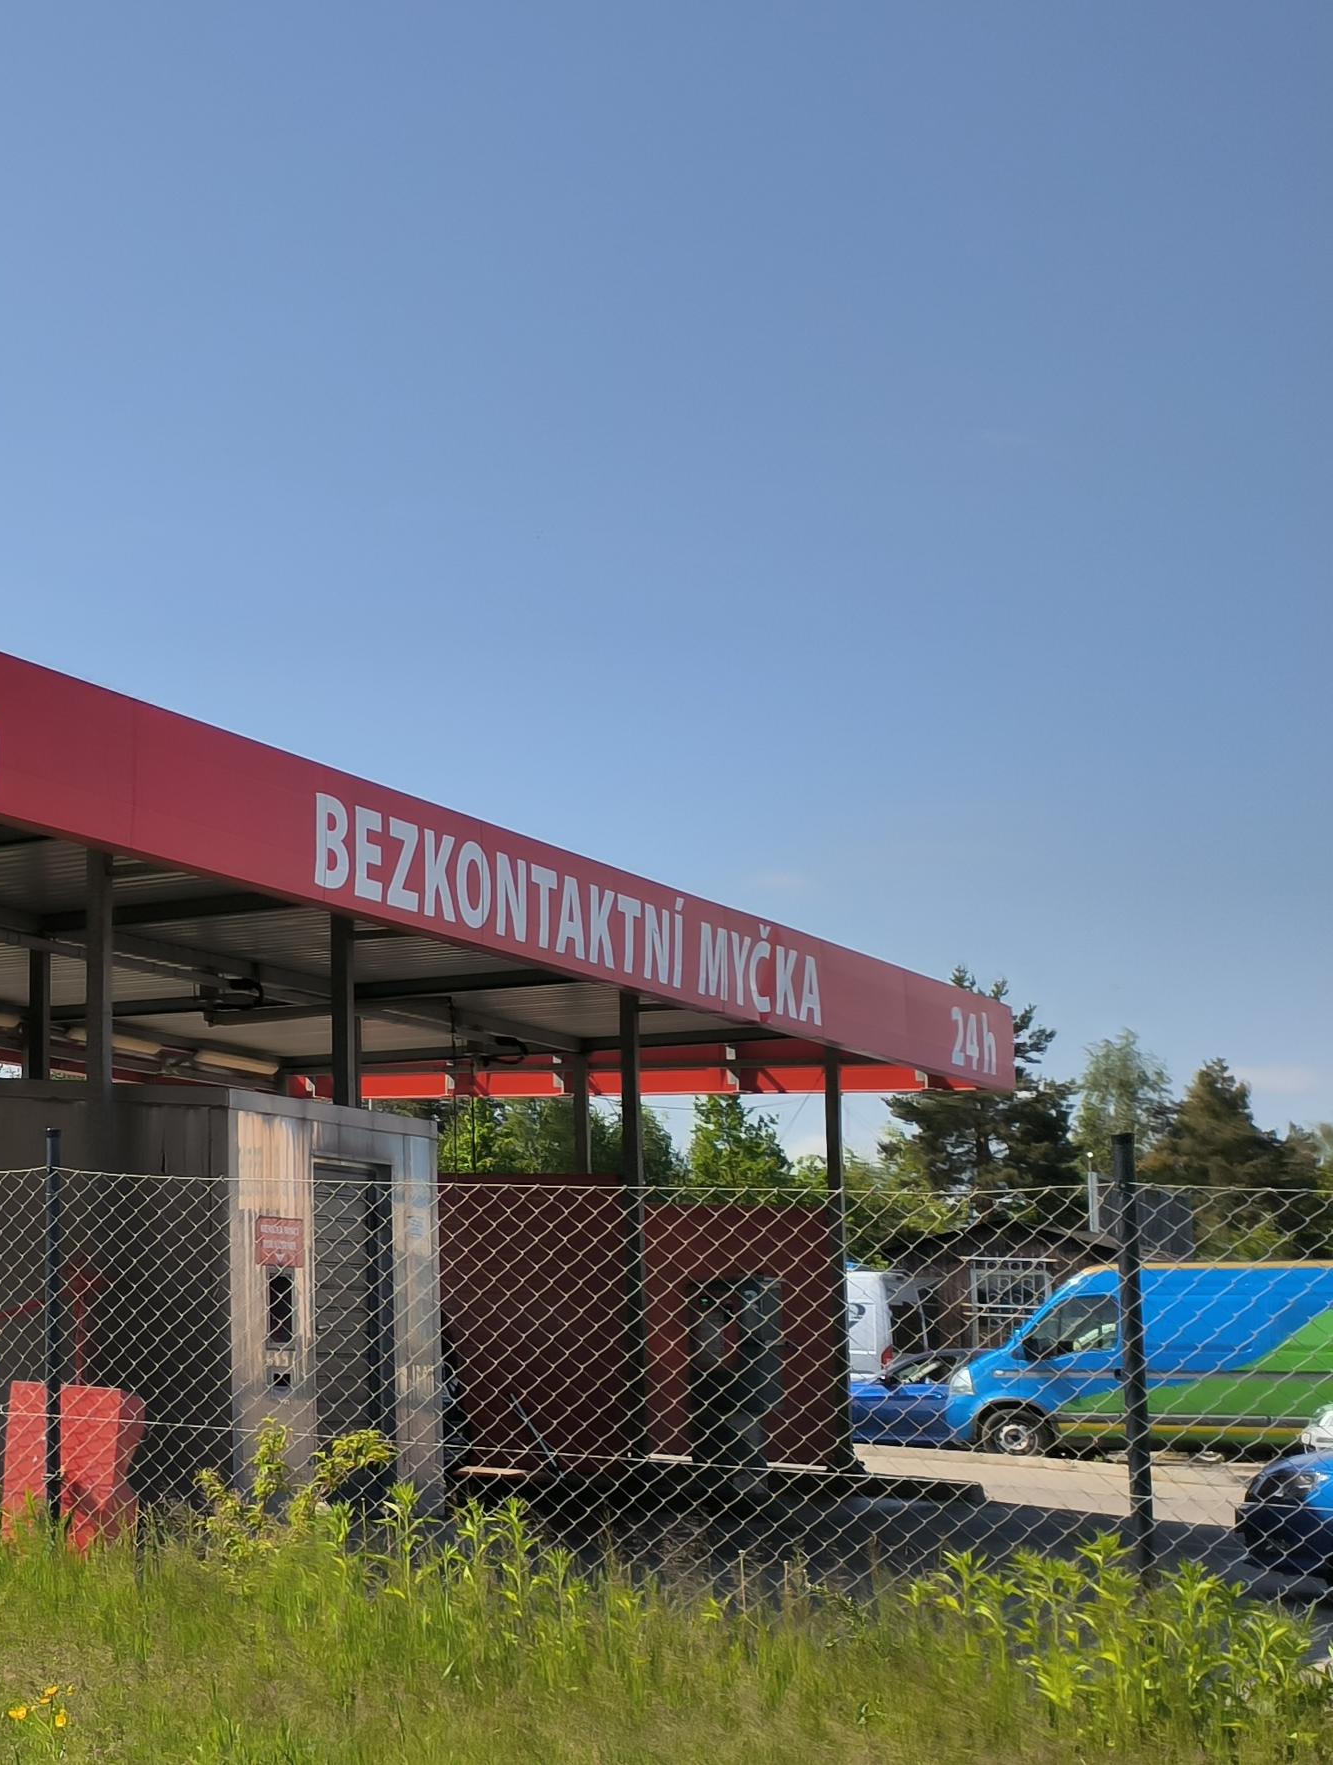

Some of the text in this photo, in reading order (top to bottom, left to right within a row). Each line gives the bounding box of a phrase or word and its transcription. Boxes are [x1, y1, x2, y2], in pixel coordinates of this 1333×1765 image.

[314, 792, 822, 1026] BEZKONTAKTNÍ MYČKA
[951, 1006, 996, 1075] 24 h
